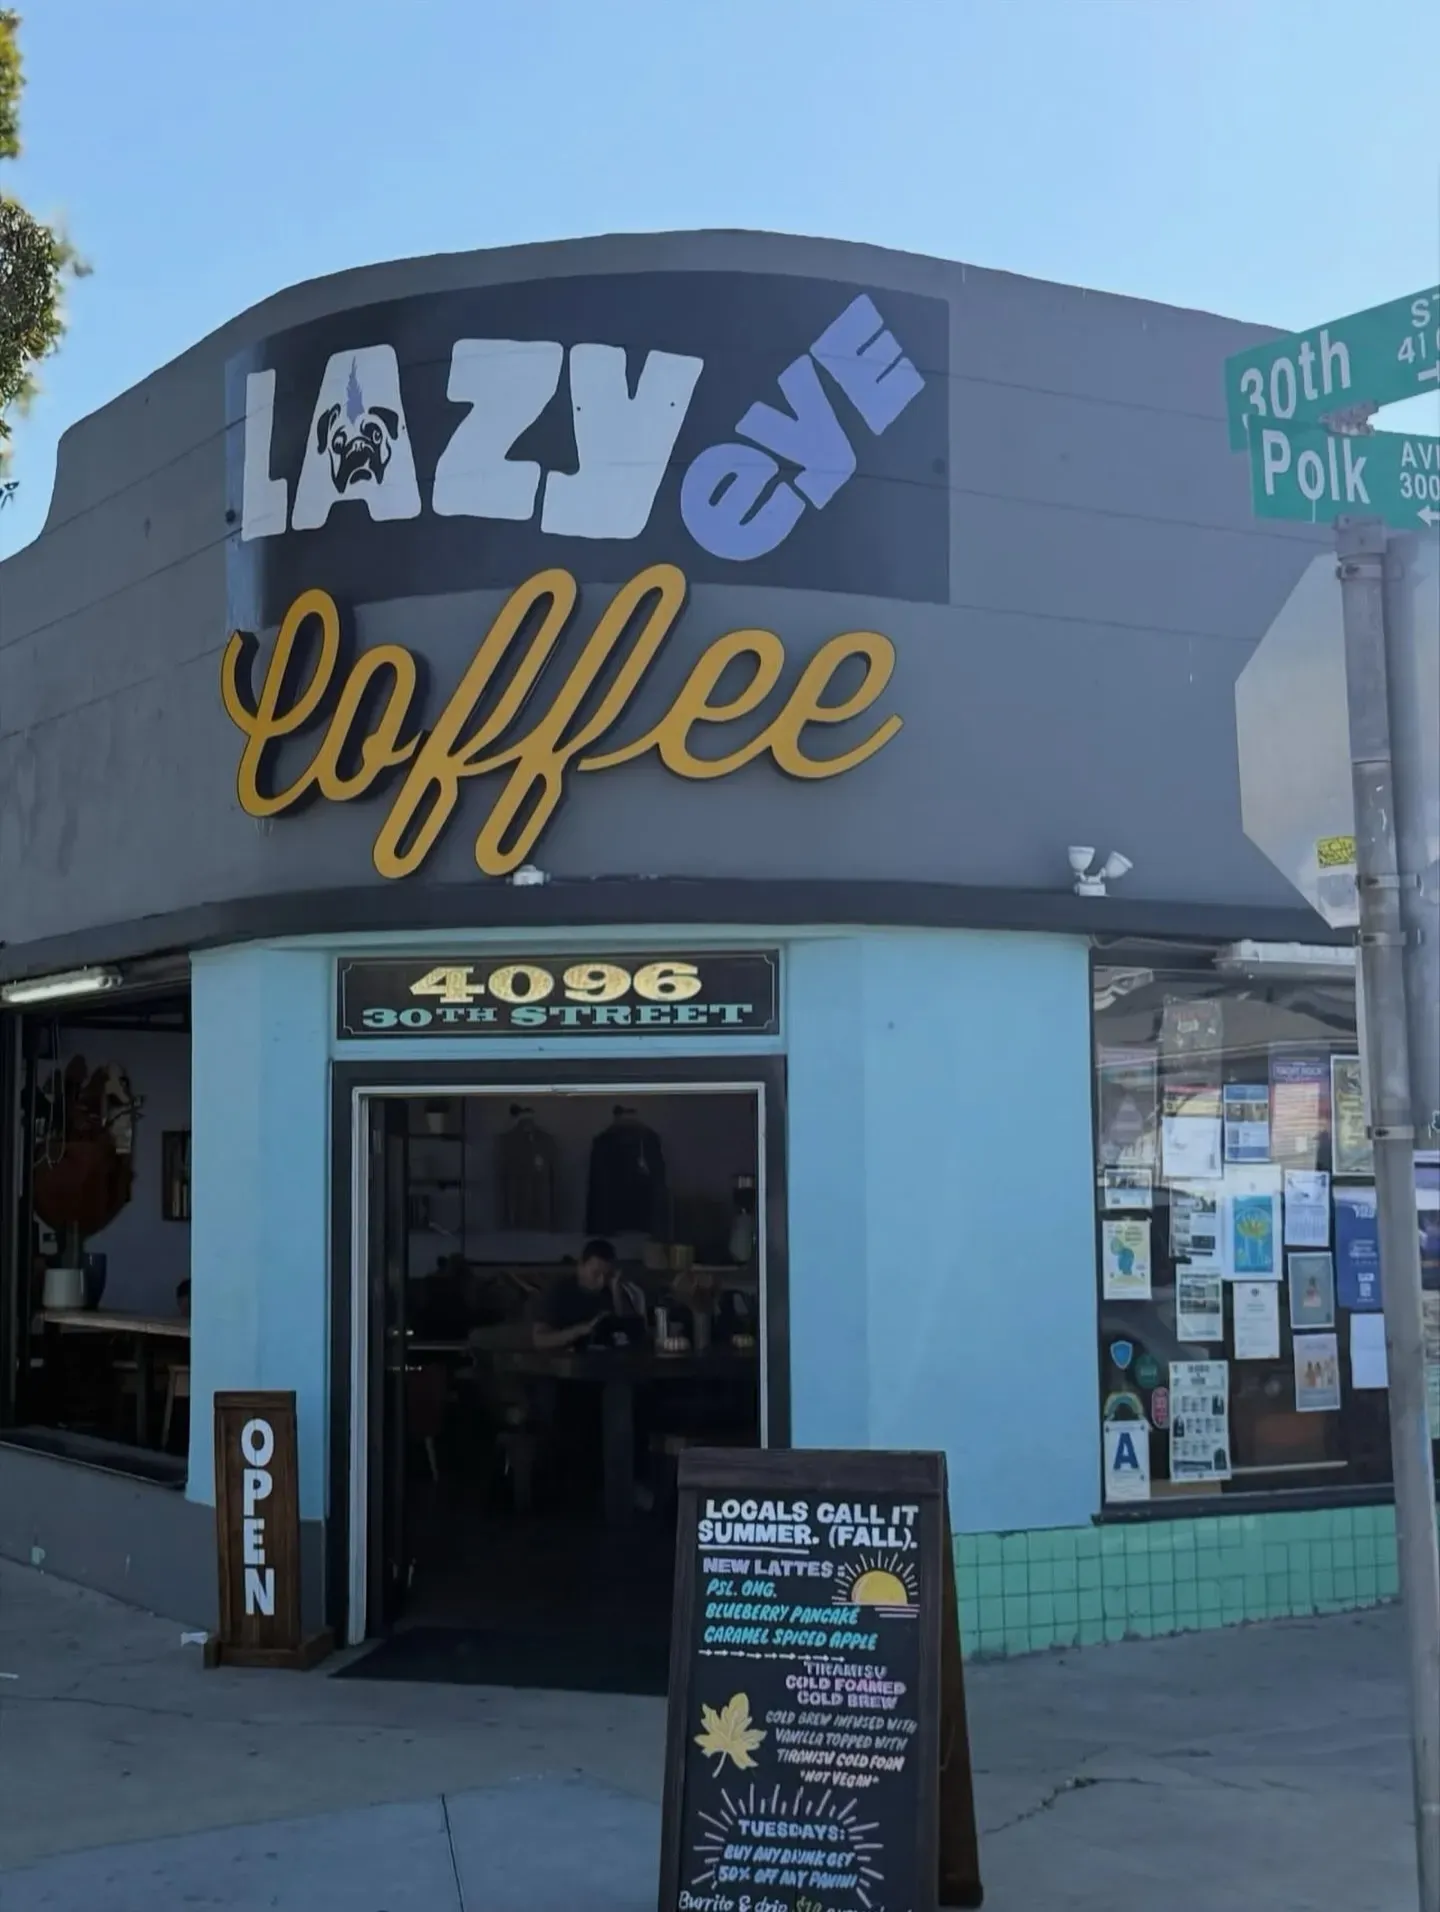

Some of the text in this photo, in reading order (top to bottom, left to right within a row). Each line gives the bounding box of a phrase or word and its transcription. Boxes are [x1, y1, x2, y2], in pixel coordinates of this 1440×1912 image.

[1240, 328, 1352, 430] 30th
[240, 336, 705, 542] LAZY
[1261, 427, 1371, 504] Polk
[221, 562, 905, 879] Coffee
[408, 961, 703, 1004] 4096
[362, 1003, 753, 1028] 30TH STREET
[1113, 1432, 1140, 1470] A
[241, 1418, 275, 1616] OPEN
[706, 1499, 919, 1526] LOCALS CALL IT
[698, 1520, 918, 1551] SUMMER. (FALL).
[703, 1557, 750, 1575] NEW
[706, 1578, 778, 1598] PSL. OMG.
[705, 1602, 861, 1625] BLUEBERRY PANCAKE
[704, 1625, 878, 1651] CARAMEL SPICED APPLE
[785, 1674, 907, 1695] COLD FOAMED
[797, 1690, 899, 1710] COLD BREW
[765, 1710, 918, 1735] COLD BREW INFUSED WITH
[775, 1727, 908, 1752] VANILLA TOPPED WITH
[836, 1752, 869, 1768] COLD
[869, 1754, 906, 1773] FOAM
[738, 1819, 845, 1841] TUESDAYS:
[723, 1844, 752, 1861] BUY
[752, 1845, 781, 1864] ANY
[826, 1851, 857, 1869] GET
[718, 1865, 751, 1881] 50%
[754, 1867, 780, 1886] OFF
[678, 1890, 735, 1911] Burrito
[738, 1894, 752, 1912] &
